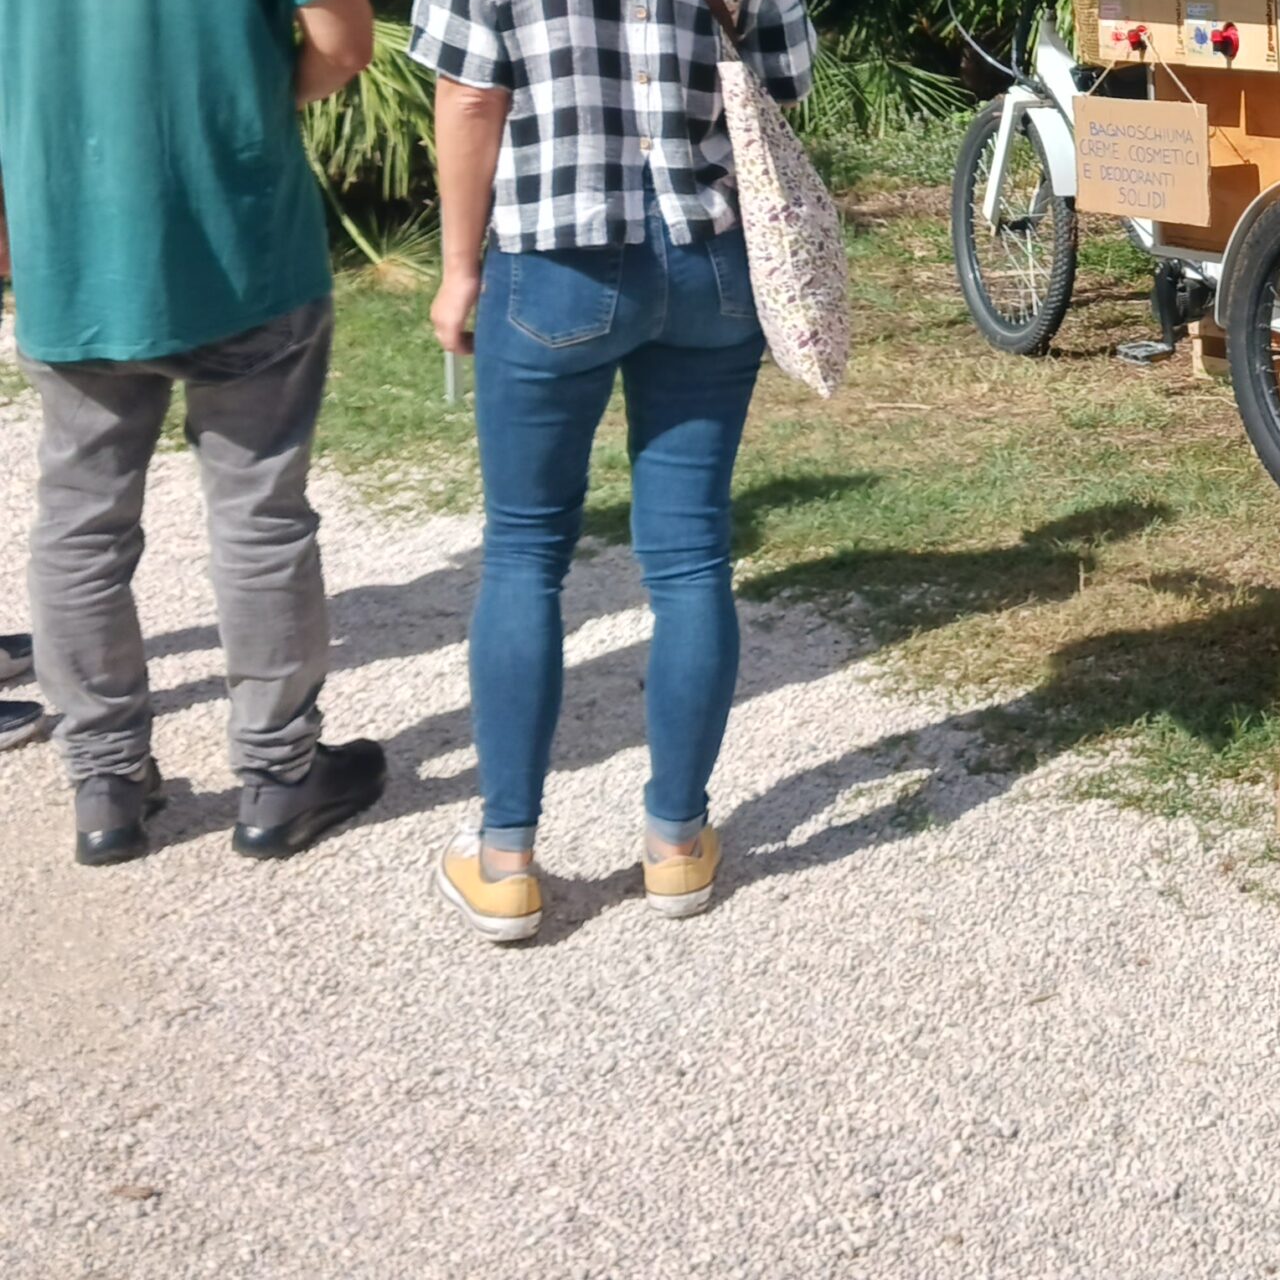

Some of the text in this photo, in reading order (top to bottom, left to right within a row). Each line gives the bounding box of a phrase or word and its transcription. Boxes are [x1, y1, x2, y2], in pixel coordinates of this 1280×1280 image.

[1089, 121, 1194, 144] BAGNOSCHIUMA
[1079, 138, 1200, 165] CREME COSMETICI
[1083, 162, 1177, 188] E DEODORANTI
[1118, 186, 1167, 209] SOLIDI
